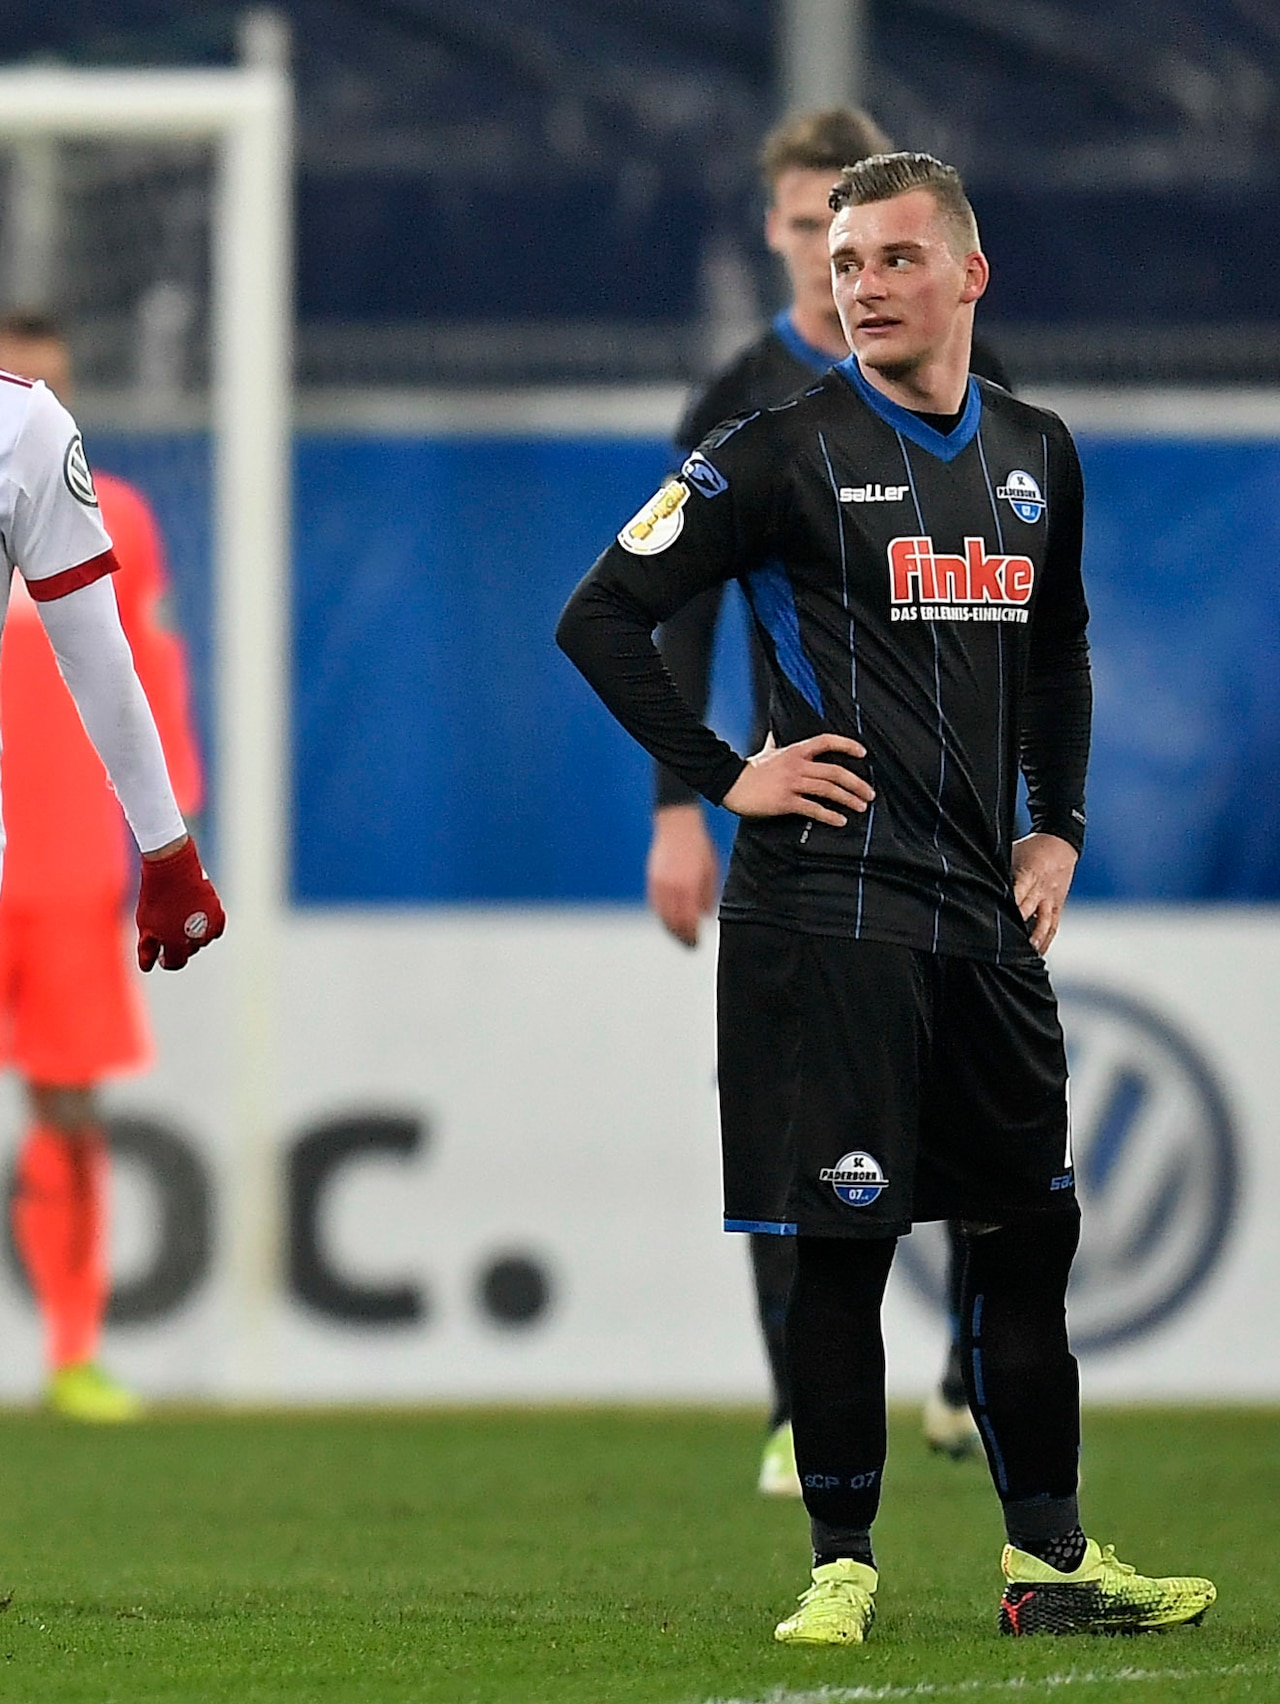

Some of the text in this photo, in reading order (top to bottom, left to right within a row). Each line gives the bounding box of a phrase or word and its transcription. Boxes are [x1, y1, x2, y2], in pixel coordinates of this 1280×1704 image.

[839, 484, 910, 502] saller
[887, 536, 1035, 605] finke
[890, 607, 918, 622] DAS
[853, 1157, 865, 1168] SC
[821, 1170, 877, 1181] PADERBORN
[804, 1470, 877, 1490] SCP 07
